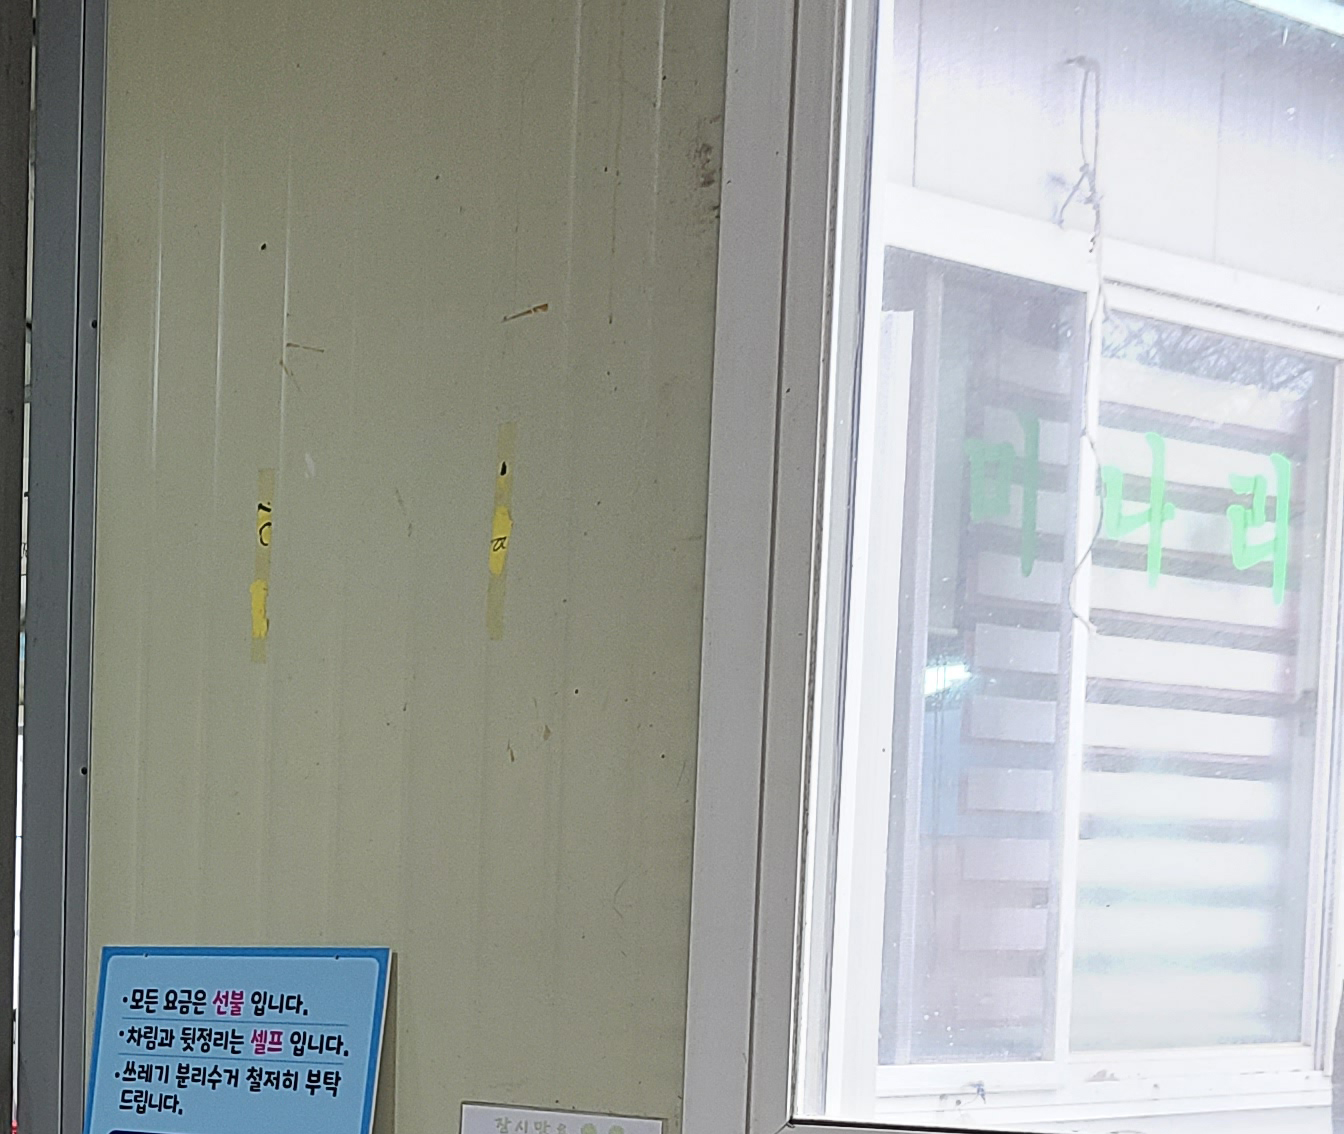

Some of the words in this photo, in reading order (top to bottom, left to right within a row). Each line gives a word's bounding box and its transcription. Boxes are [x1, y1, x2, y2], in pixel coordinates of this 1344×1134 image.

[130, 989, 159, 1011] 모든
[162, 989, 207, 1014] 요금은
[212, 990, 245, 1017] 선불
[250, 991, 309, 1017] 입니다.
[126, 1026, 175, 1049] 차림과
[180, 1028, 245, 1054] 뒷정리는
[250, 1030, 283, 1056] 셀프
[289, 1032, 350, 1058] 입니다.
[122, 1061, 170, 1085] 쓰레기
[175, 1063, 239, 1090] 분리수거
[245, 1066, 298, 1092] 철저히
[305, 1069, 341, 1097] 부탁
[119, 1089, 184, 1115] 드립니다.
